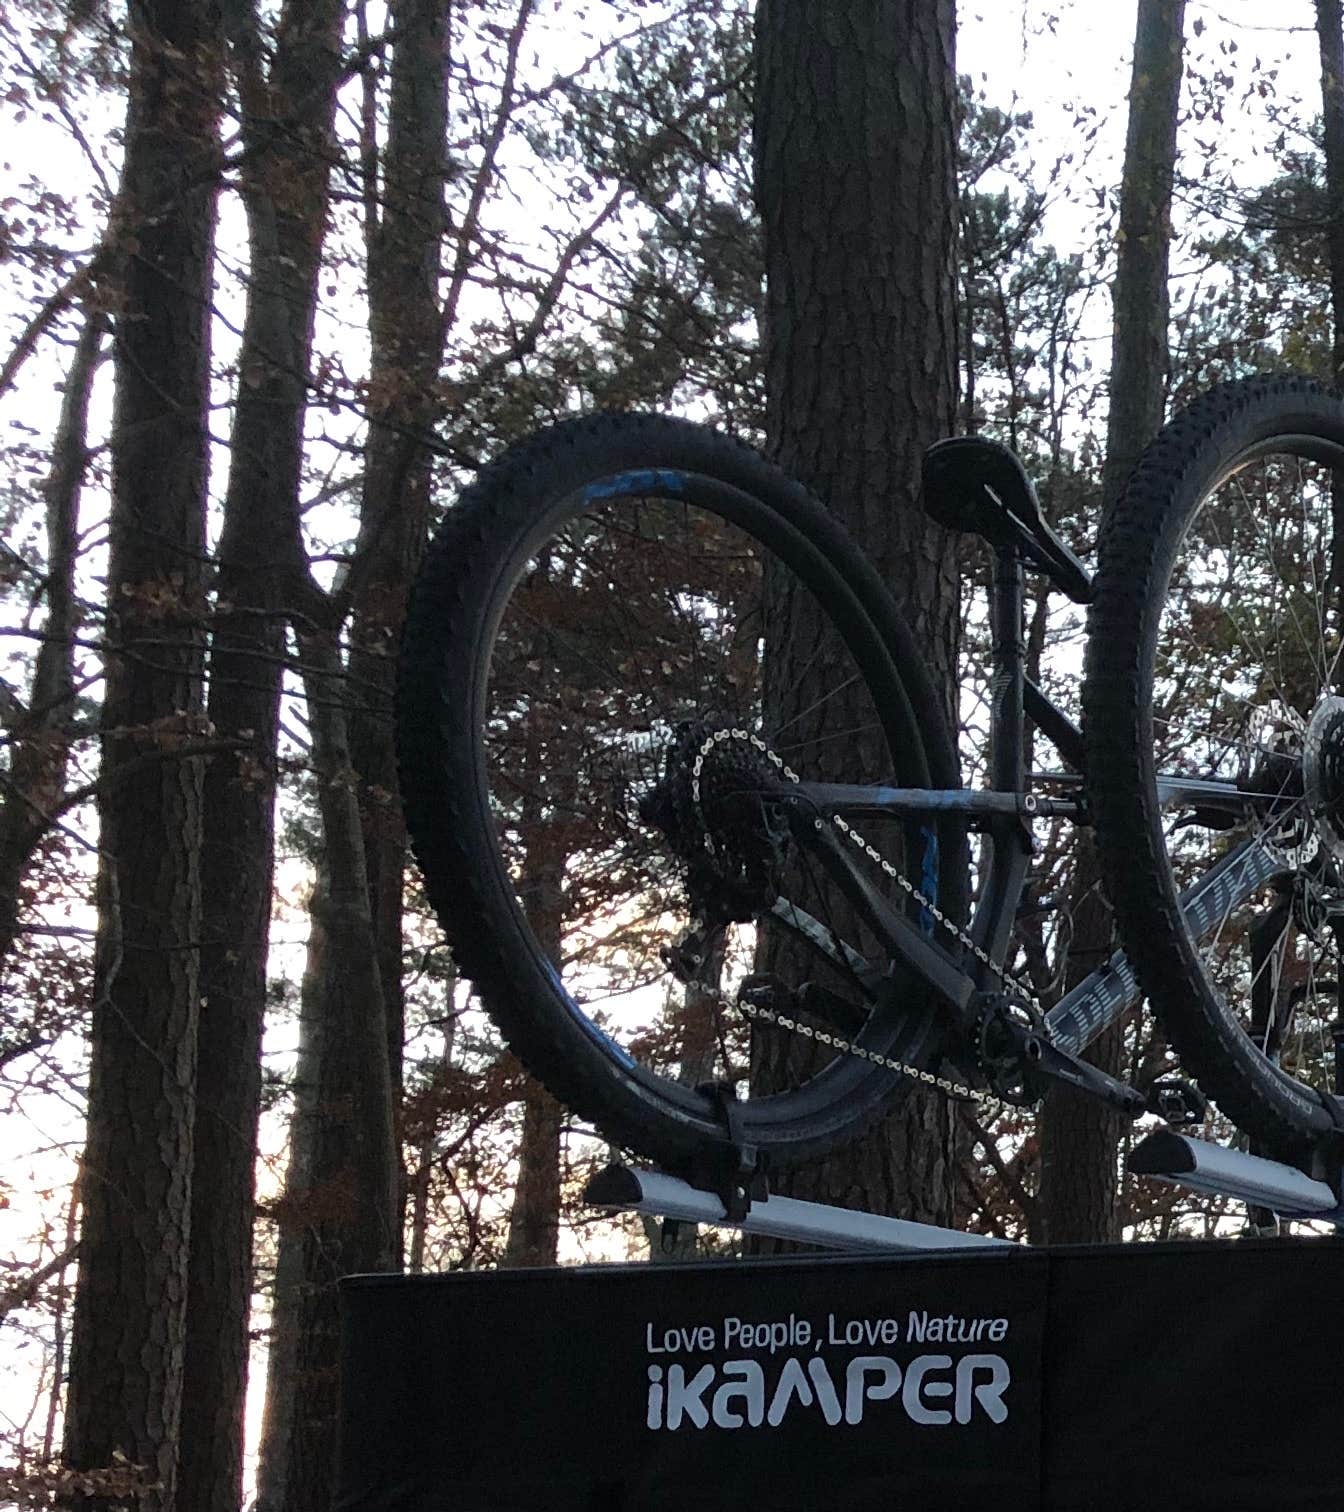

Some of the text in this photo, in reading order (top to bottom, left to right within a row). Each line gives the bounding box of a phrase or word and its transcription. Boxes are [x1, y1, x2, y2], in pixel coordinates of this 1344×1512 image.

[647, 1310, 1009, 1354] Love People, Love Nature
